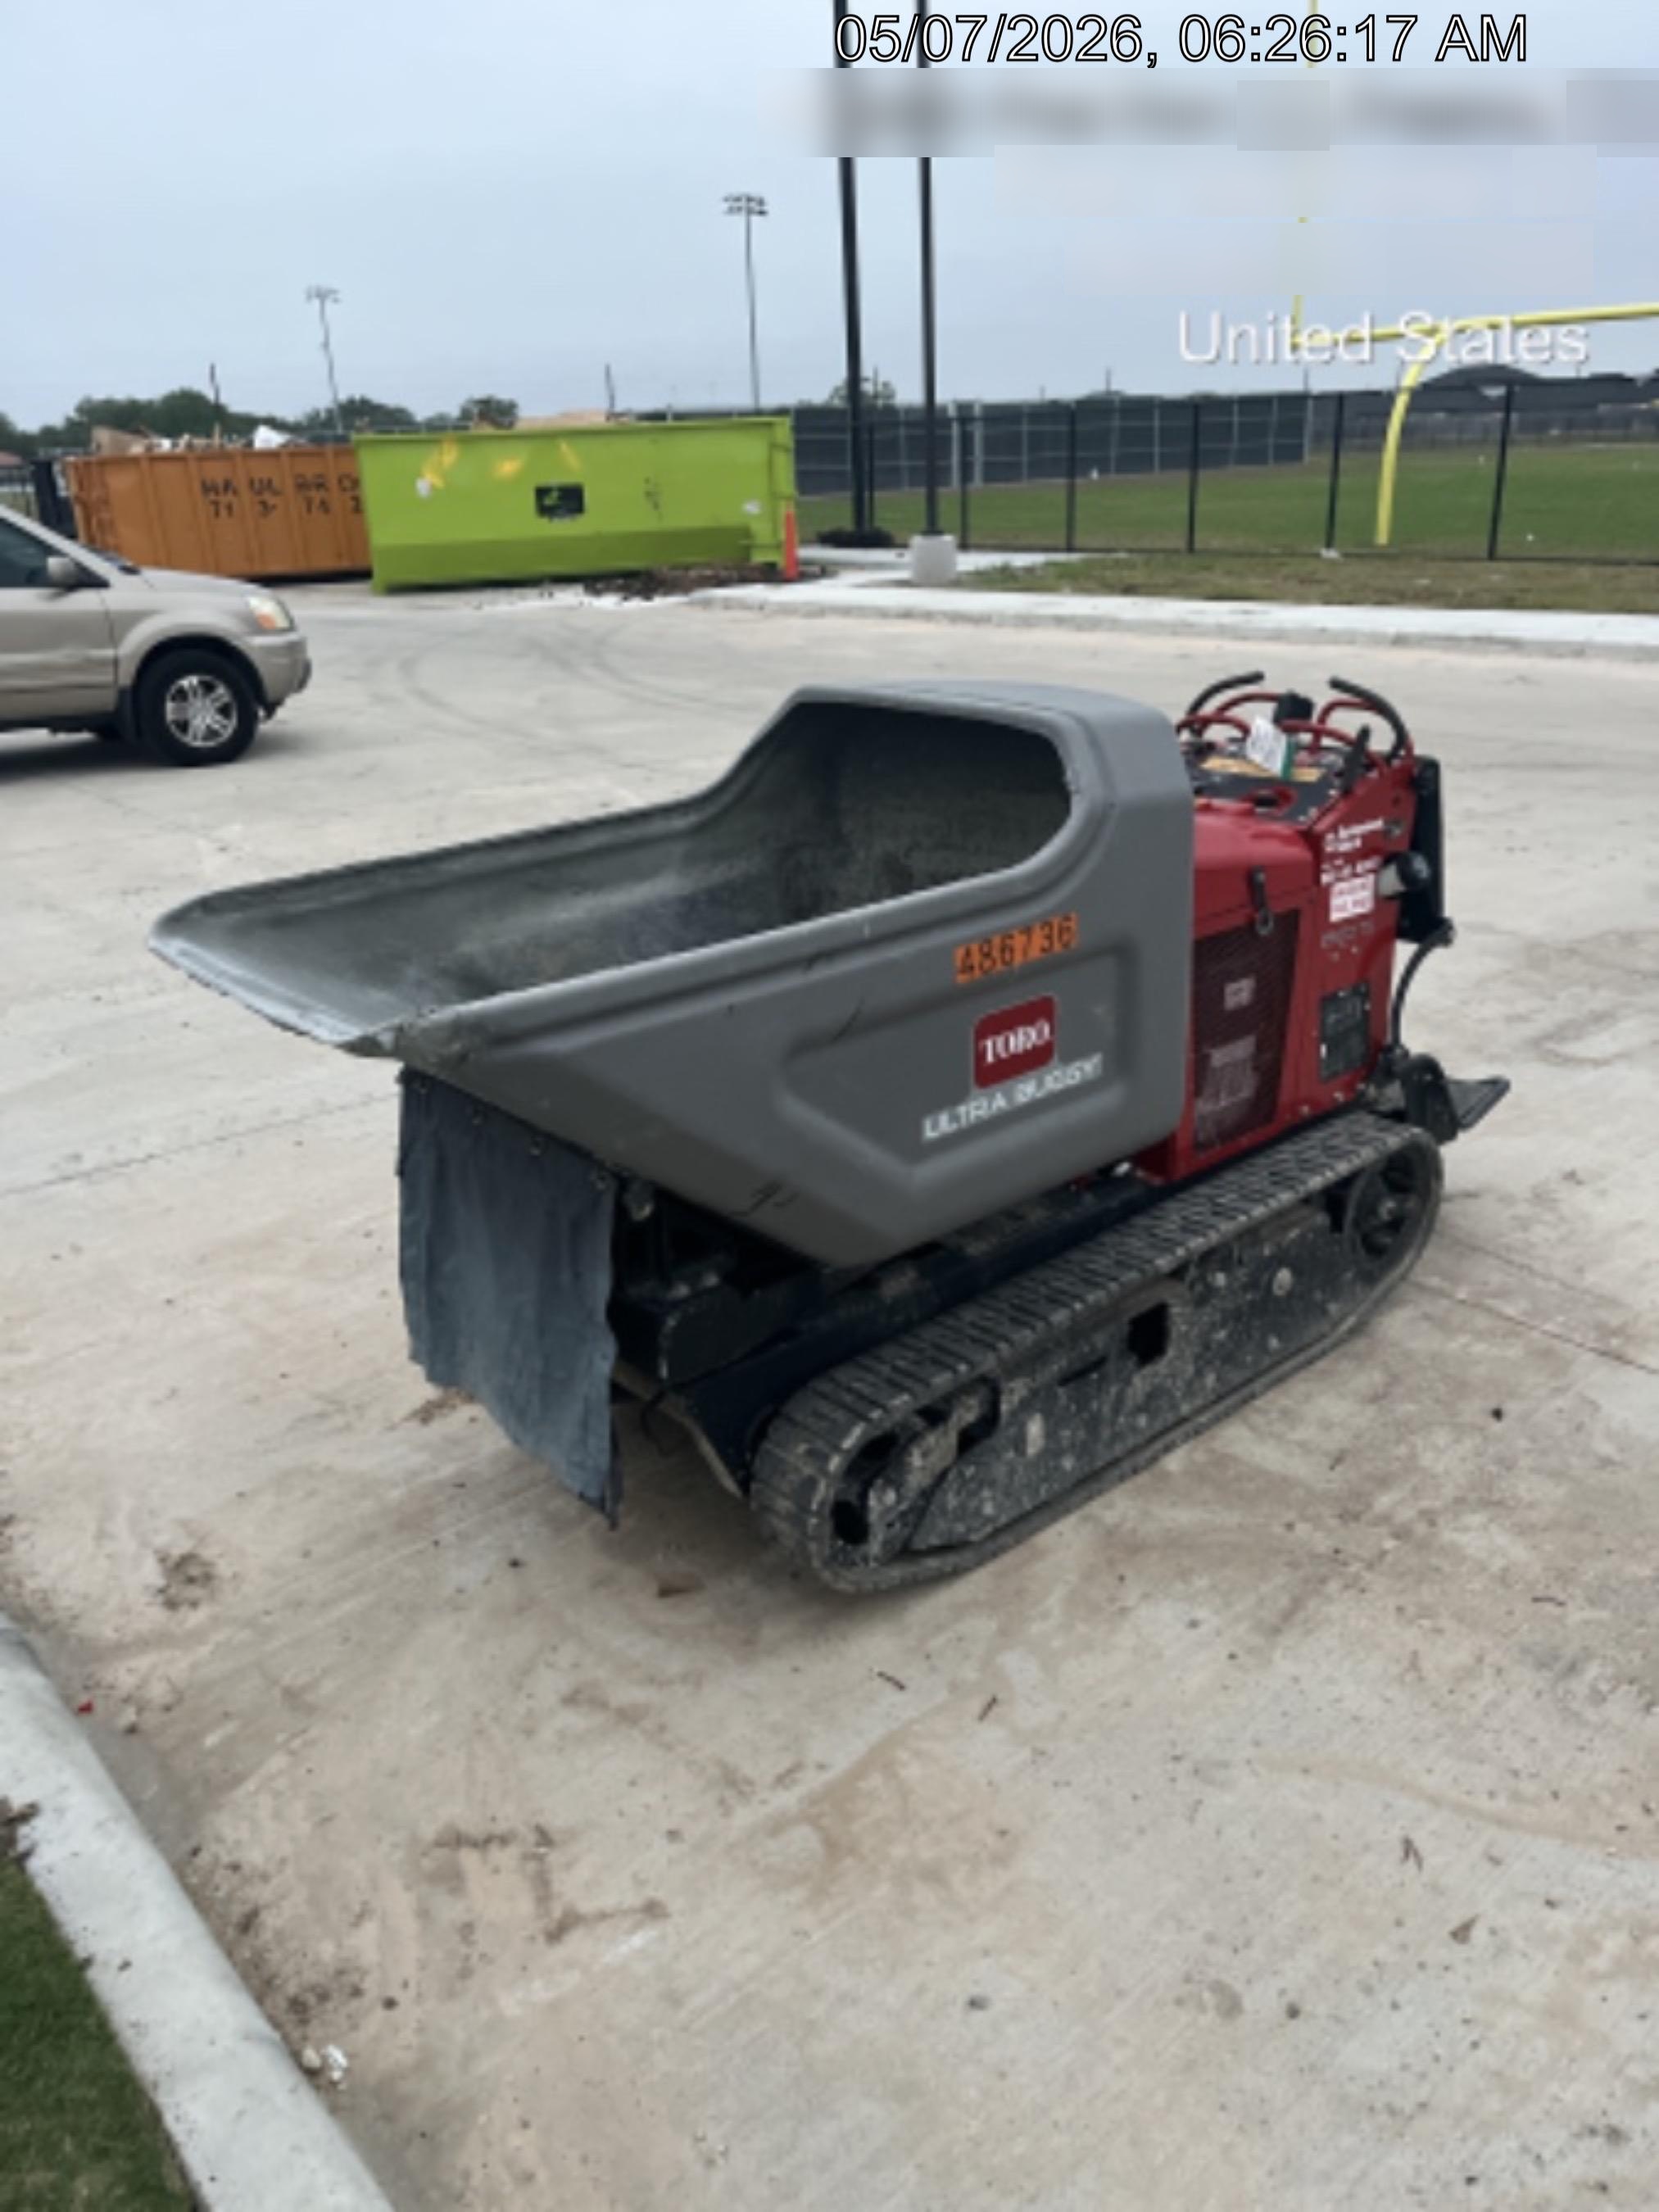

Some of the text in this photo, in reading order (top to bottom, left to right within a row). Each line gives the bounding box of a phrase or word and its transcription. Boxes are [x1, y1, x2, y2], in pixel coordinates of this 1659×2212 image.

[955, 913, 1075, 977] 486736
[981, 1018, 1052, 1065] TORO
[922, 1090, 1009, 1140] ULTRA
